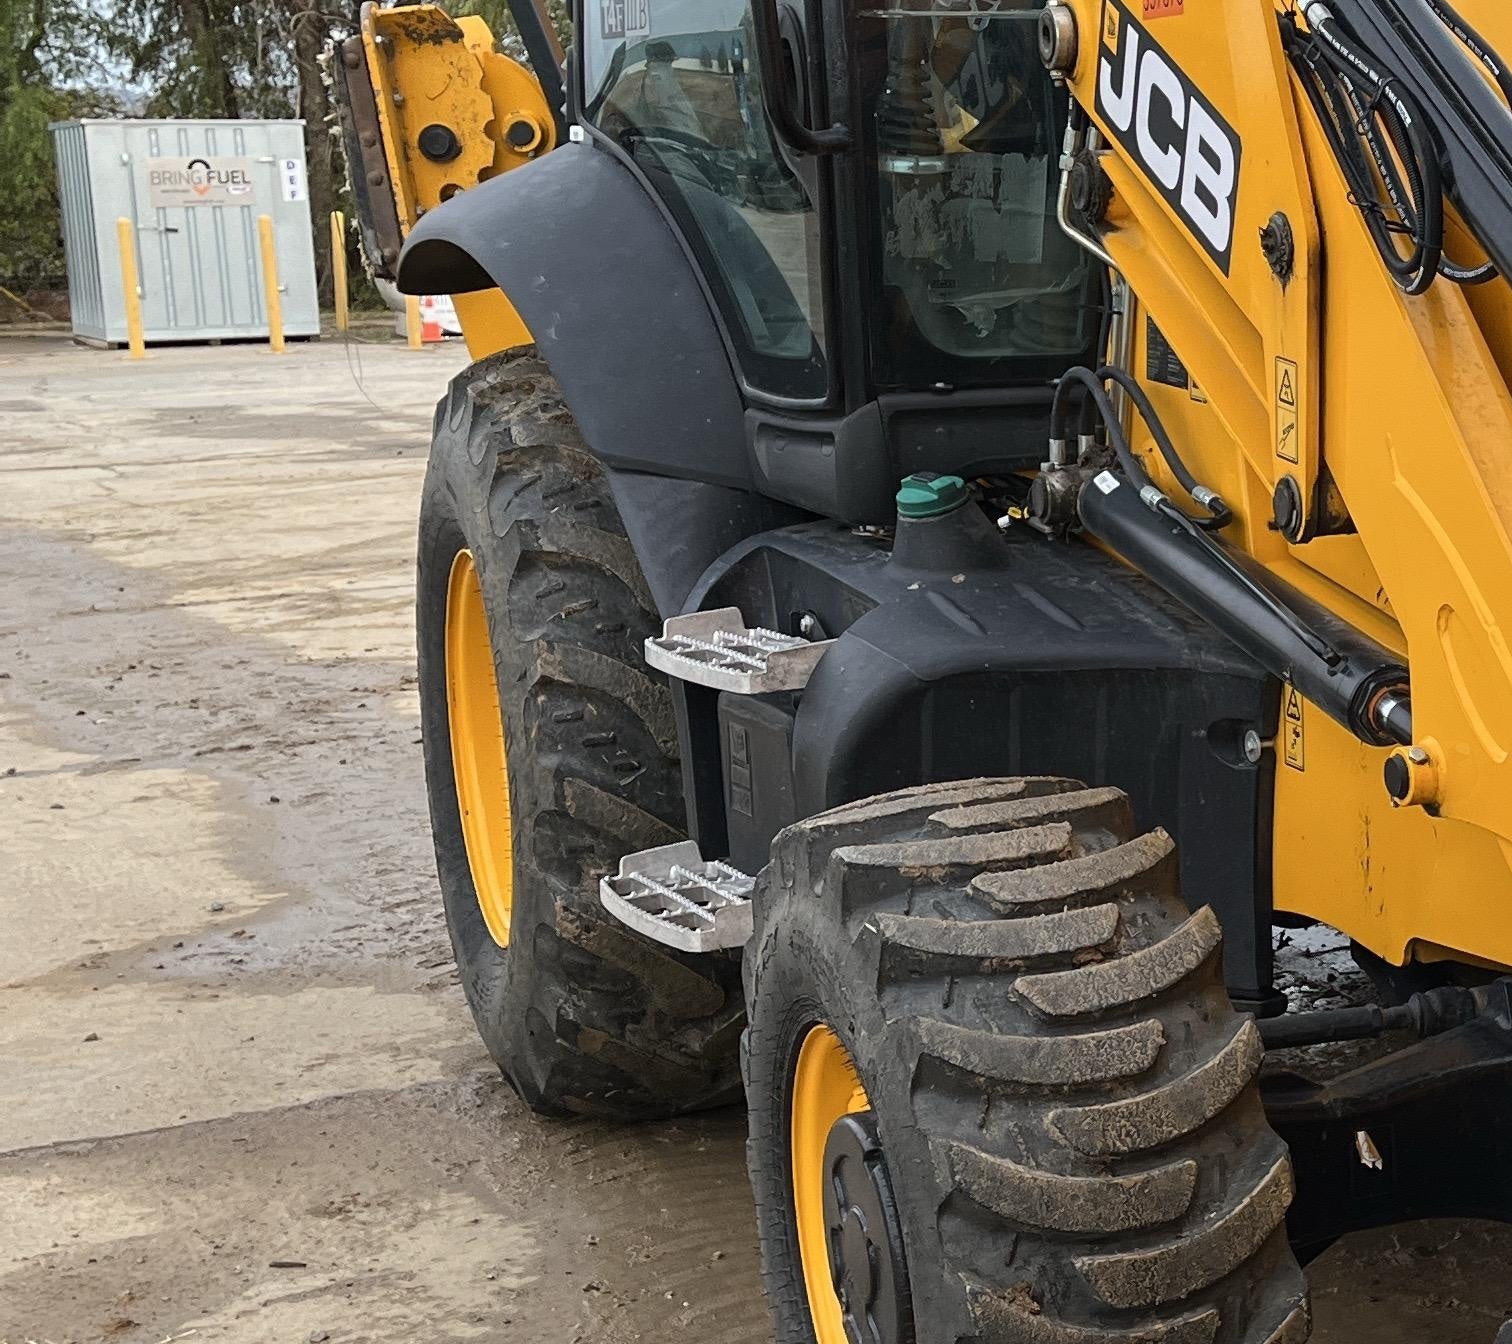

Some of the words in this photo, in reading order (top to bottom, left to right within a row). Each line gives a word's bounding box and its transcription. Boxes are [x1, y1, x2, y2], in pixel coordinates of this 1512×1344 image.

[150, 169, 202, 186] BRING
[206, 169, 252, 185] FUEL
[1100, 23, 1235, 253] JCB
